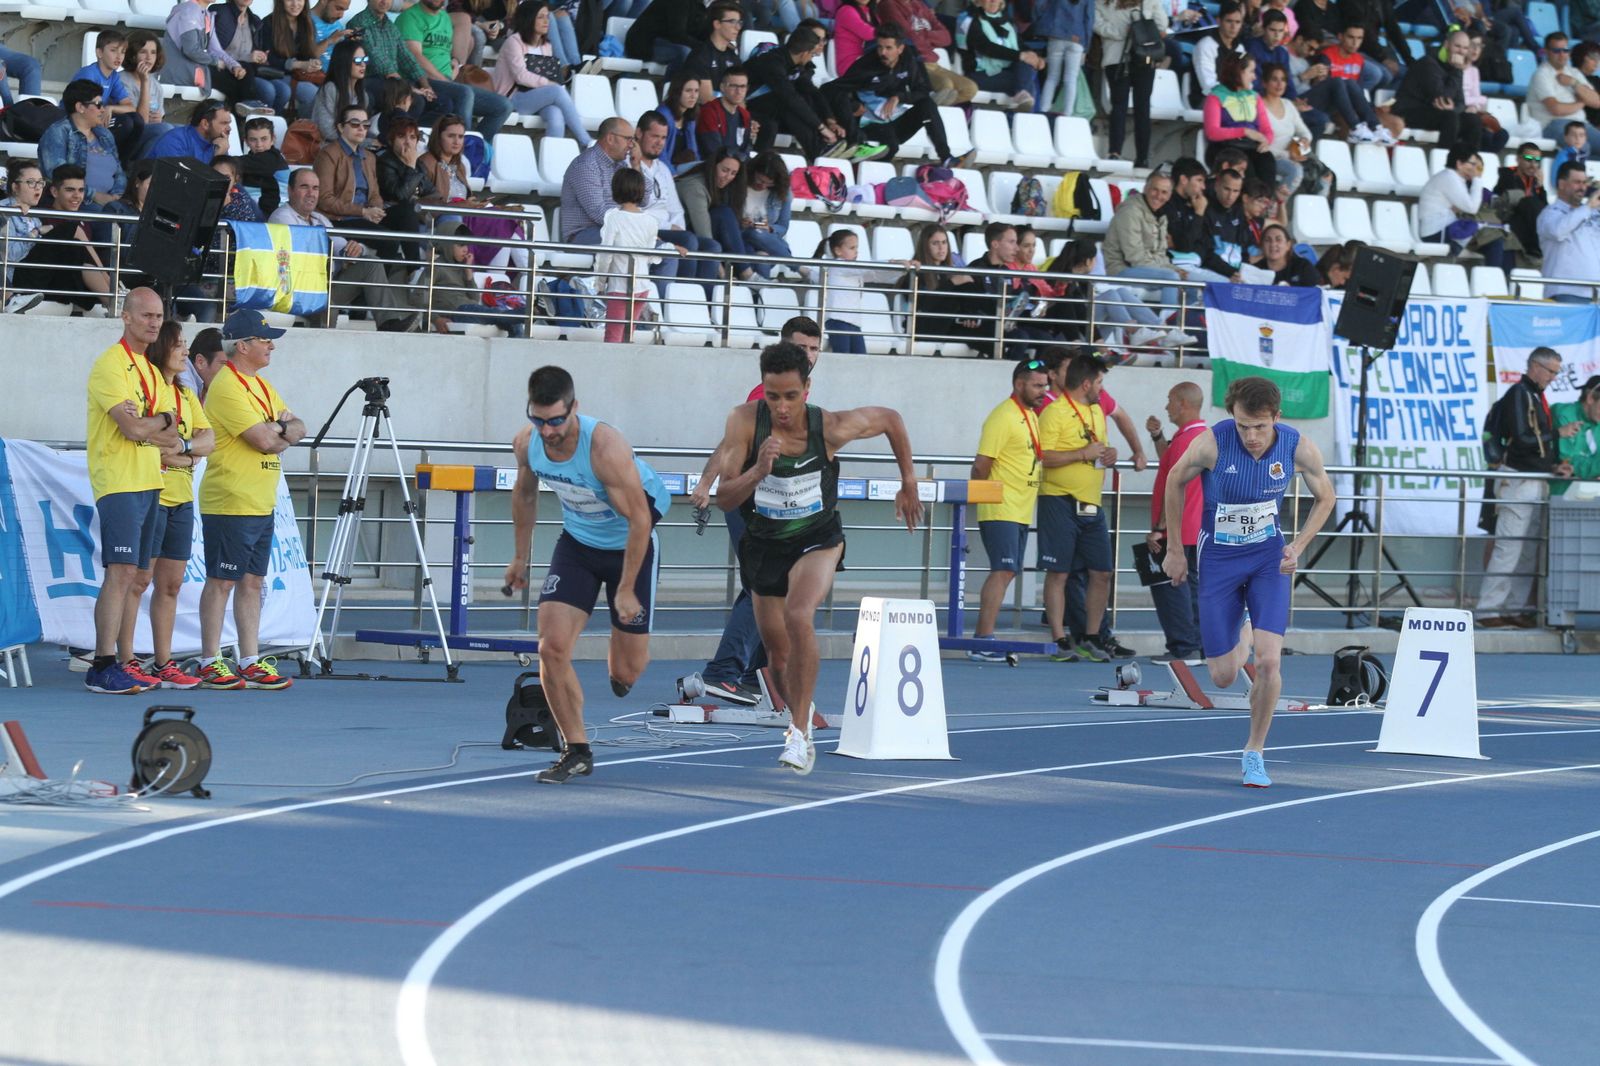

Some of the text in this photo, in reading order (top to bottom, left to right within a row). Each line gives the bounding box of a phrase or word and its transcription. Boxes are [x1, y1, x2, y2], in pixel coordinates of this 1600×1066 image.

[1442, 305, 1471, 347] DE
[782, 500, 797, 509] 16
[1217, 514, 1237, 523] DE
[1241, 525, 1255, 535] 18
[38, 500, 96, 581] H
[114, 546, 132, 554] RFEA
[220, 562, 238, 572] RFEA
[461, 553, 470, 606] MONDO
[888, 611, 934, 625] MONDO
[1408, 619, 1467, 633] MONDO
[855, 644, 924, 717] 8 8
[1416, 650, 1450, 718] 7
